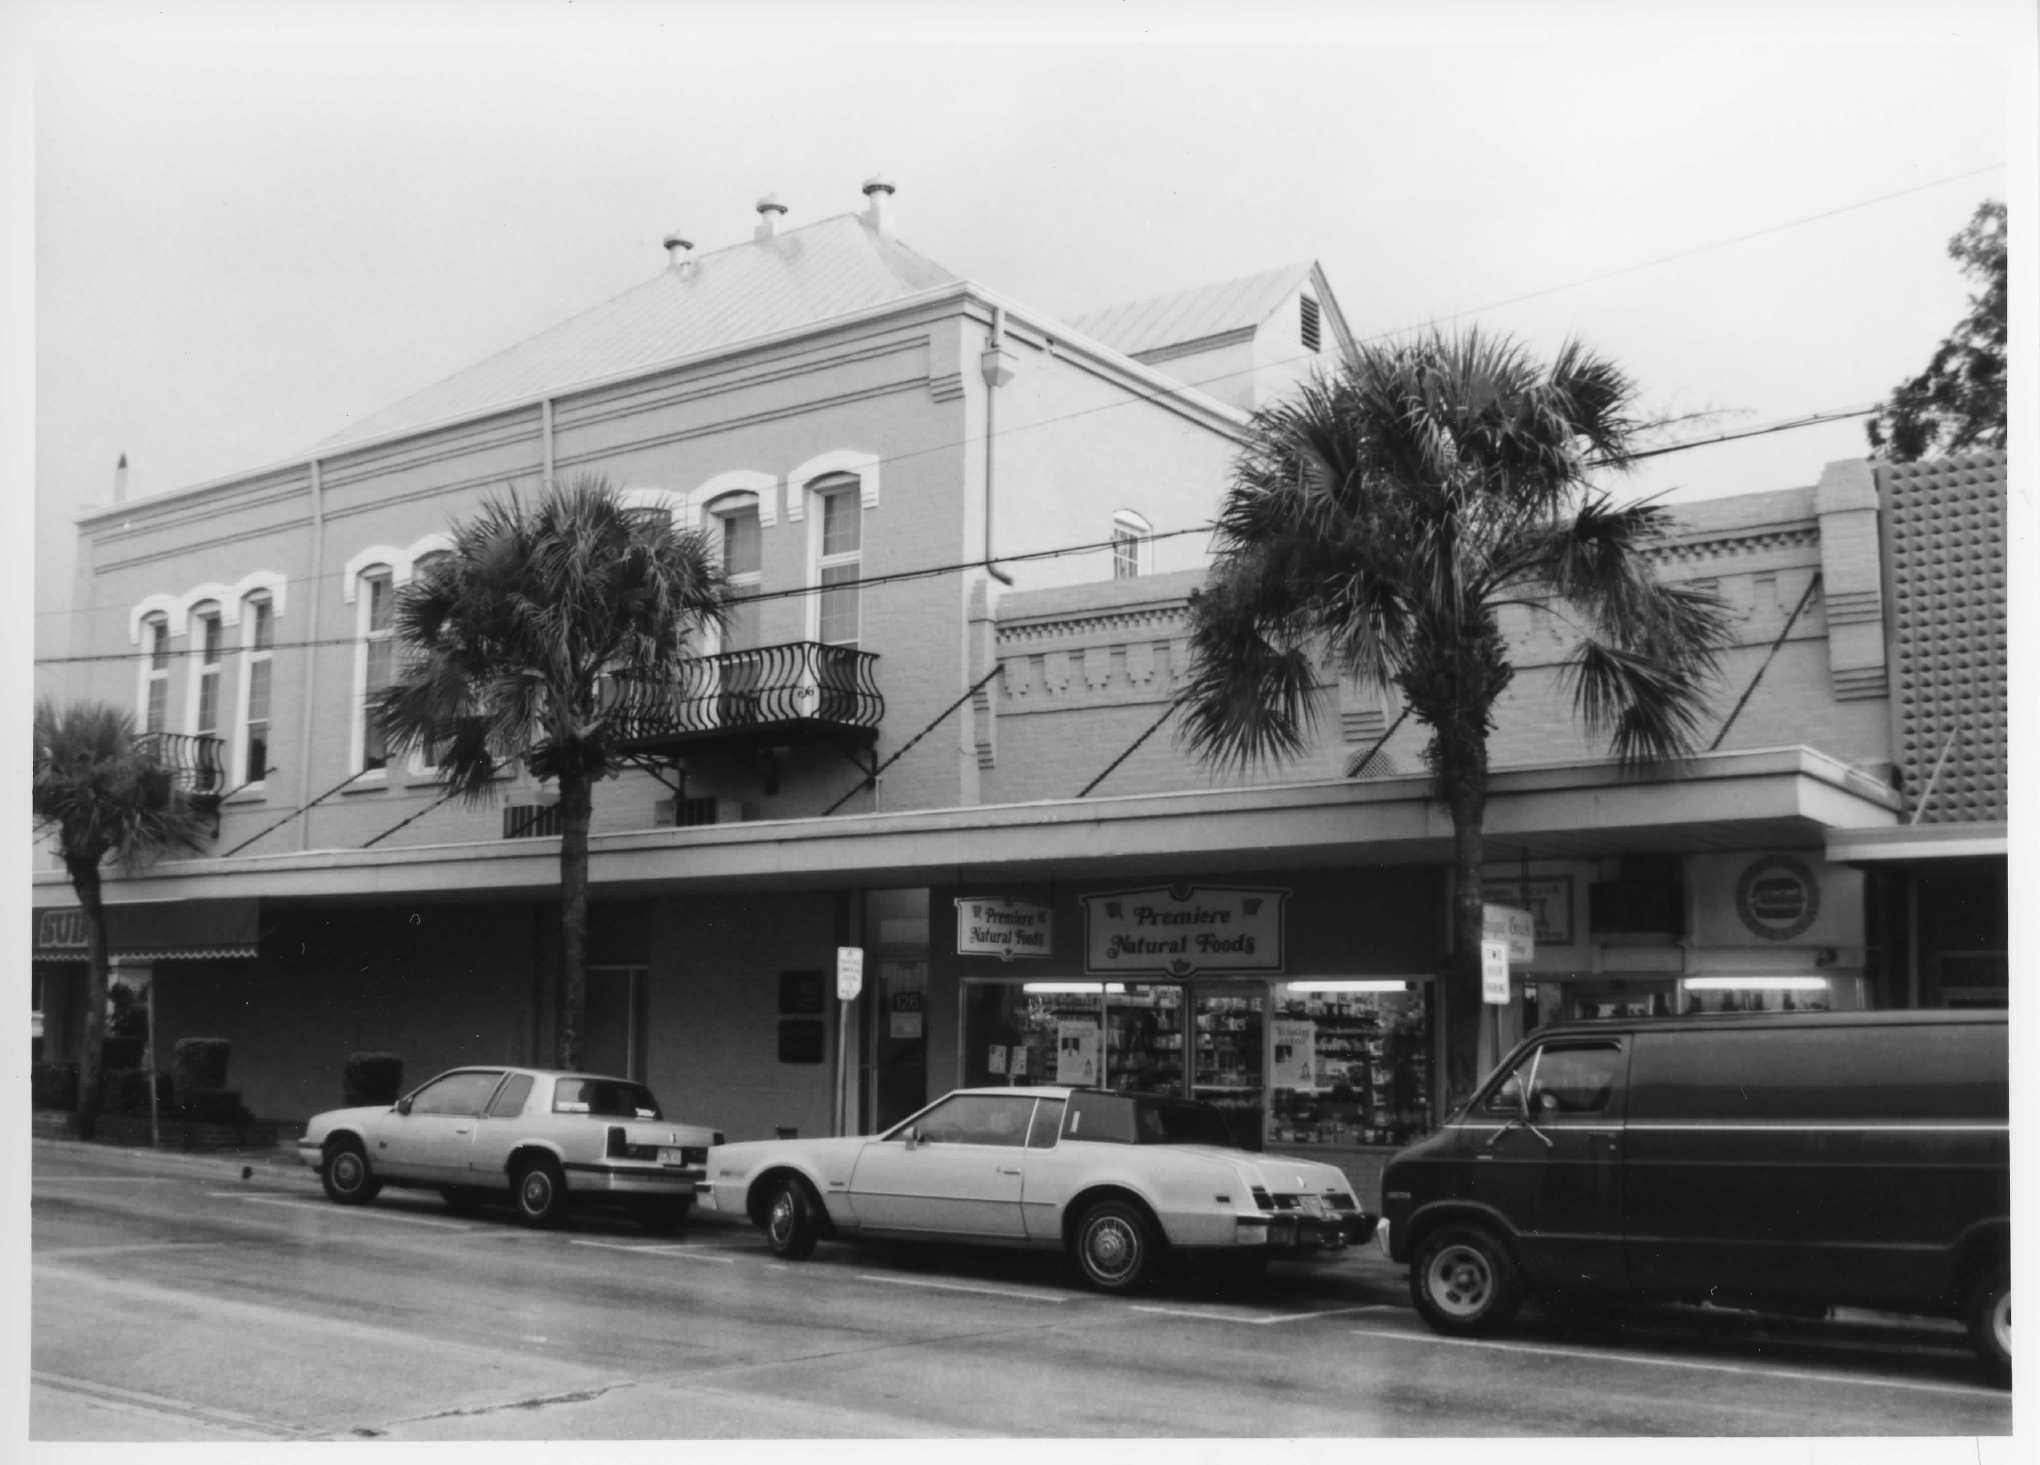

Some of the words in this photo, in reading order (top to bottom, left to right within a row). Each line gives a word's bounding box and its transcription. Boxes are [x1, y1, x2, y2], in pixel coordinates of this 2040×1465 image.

[985, 907, 1035, 926] Premiere
[1133, 905, 1232, 926] Premiere
[969, 926, 1012, 946] Natural
[1014, 928, 1045, 947] Foods
[1106, 933, 1187, 959] Natural
[1194, 932, 1256, 955] Foods
